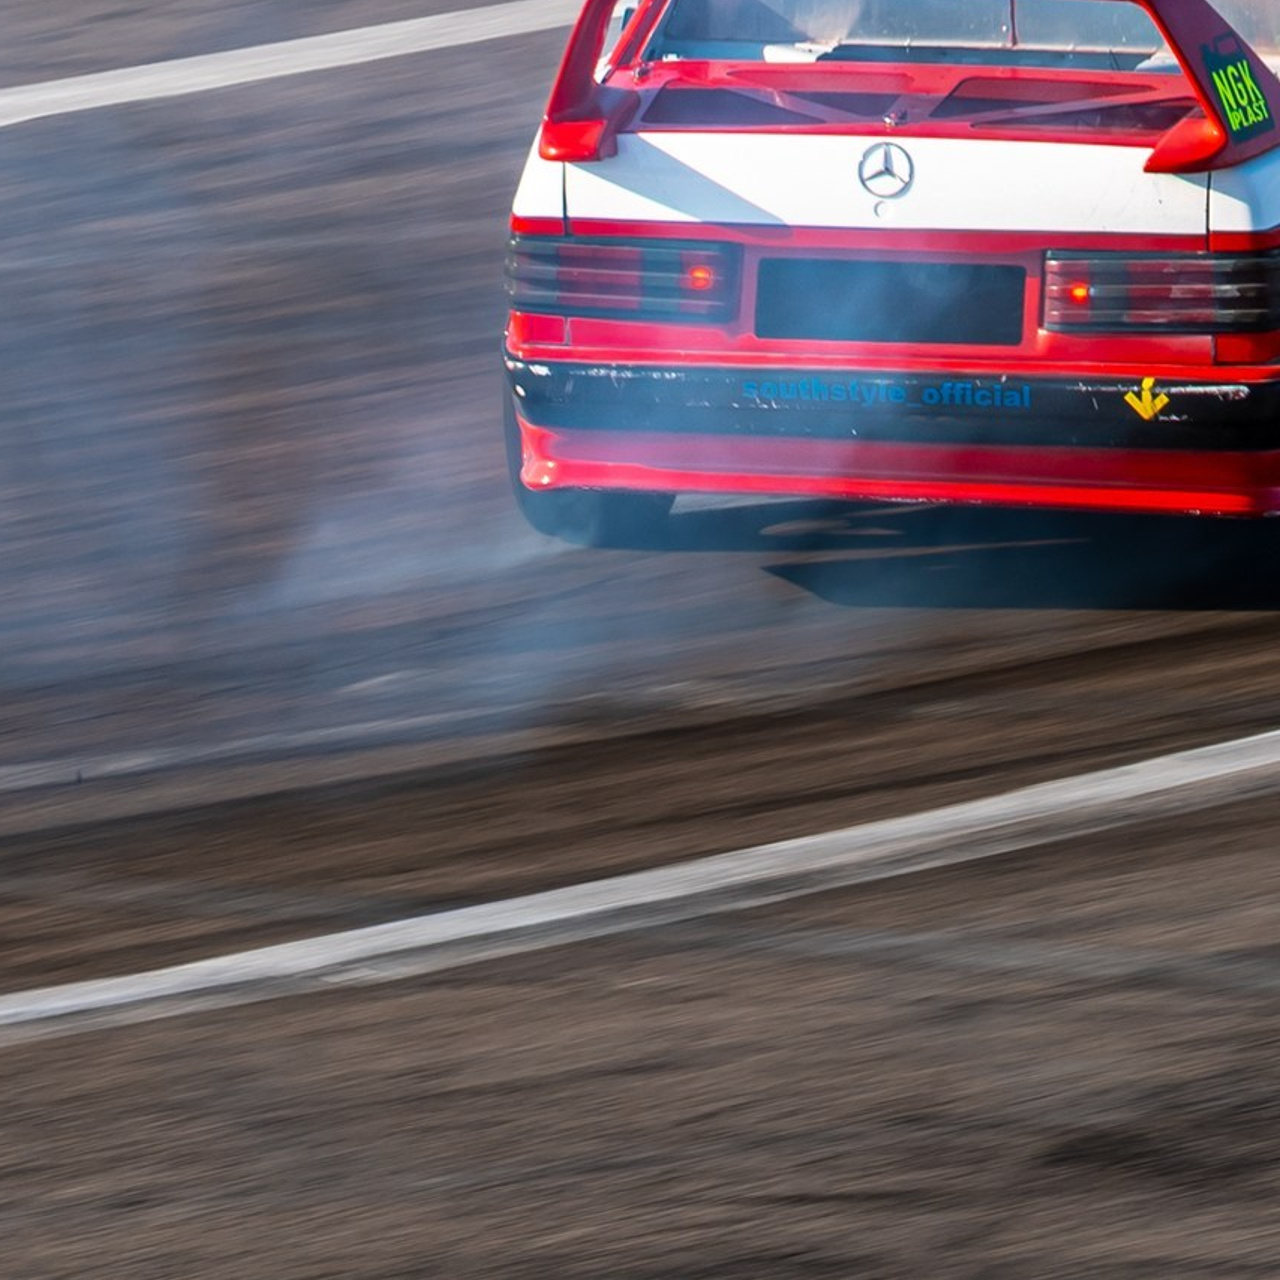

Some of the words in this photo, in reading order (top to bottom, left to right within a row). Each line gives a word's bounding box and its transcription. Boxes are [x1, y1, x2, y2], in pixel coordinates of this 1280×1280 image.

[1212, 59, 1264, 116] NGK
[1230, 99, 1269, 131] PLAST
[741, 377, 1031, 408] southstyle_official
